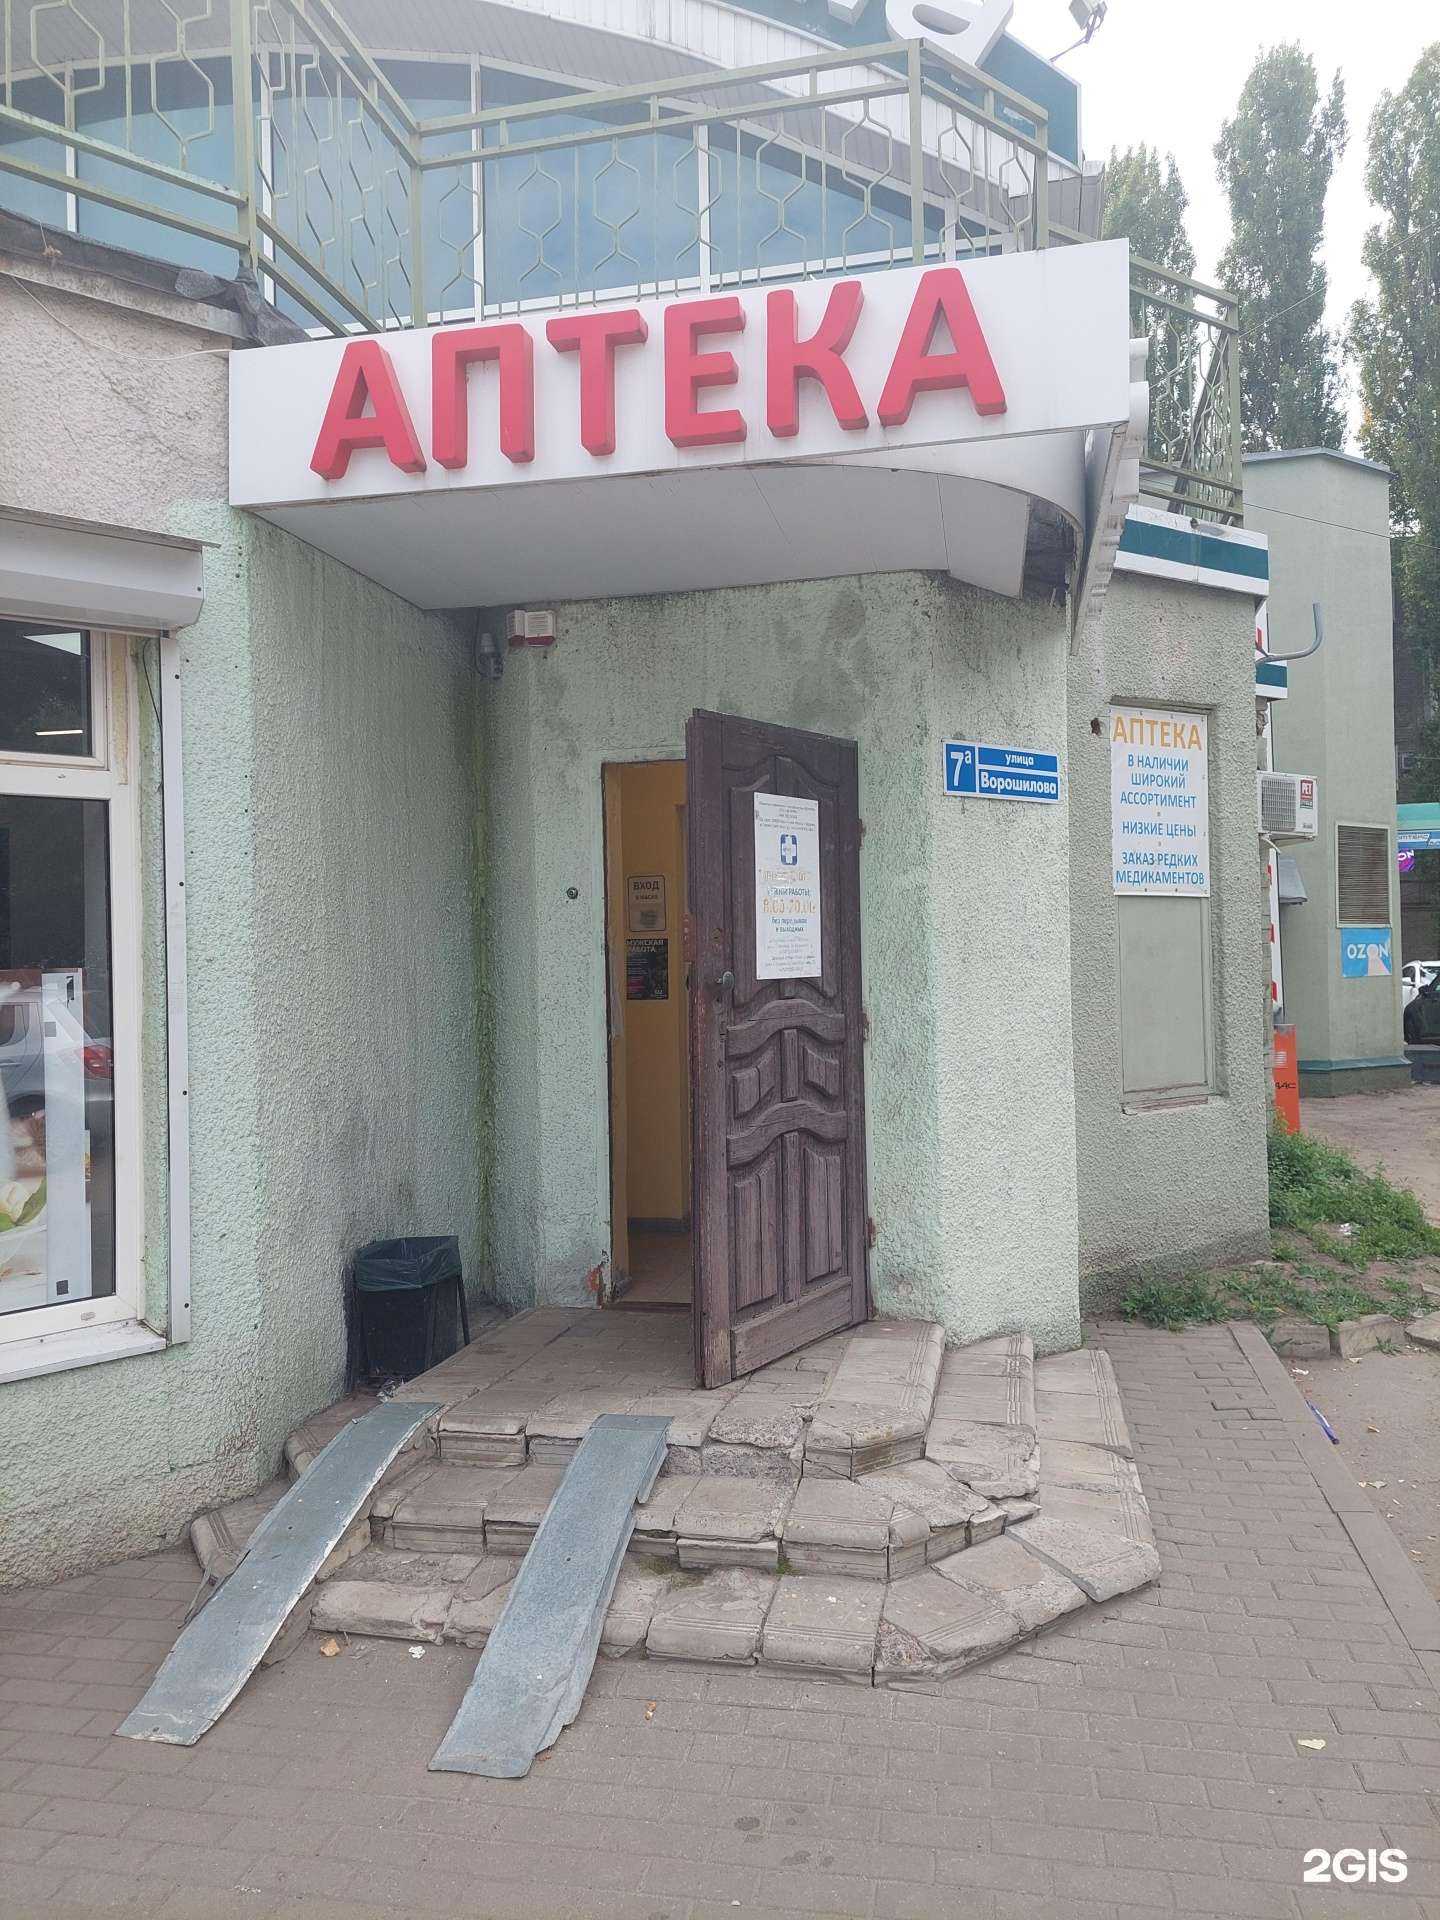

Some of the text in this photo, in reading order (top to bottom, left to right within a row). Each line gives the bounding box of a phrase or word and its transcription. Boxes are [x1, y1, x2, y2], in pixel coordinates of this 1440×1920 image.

[310, 268, 1006, 480] АПТЕКА
[1112, 716, 1203, 751] АПТЕКА
[1005, 754, 1034, 766] улица
[1127, 754, 1189, 772] В НАЛИЧИИ
[980, 771, 1057, 794] Ворошилова
[1131, 772, 1186, 789] ШИРОКИЙ
[1120, 791, 1197, 809] АССОРТИМЕНТ
[1122, 821, 1197, 839] НИЗКИЕ ЦЕНЫ
[1122, 851, 1199, 869] ЗАКАЗ РЕДКИХ
[633, 880, 660, 891] ВХОД
[1116, 870, 1205, 887] МЕДИКАМЕНТОВ
[1347, 943, 1390, 960] OZON
